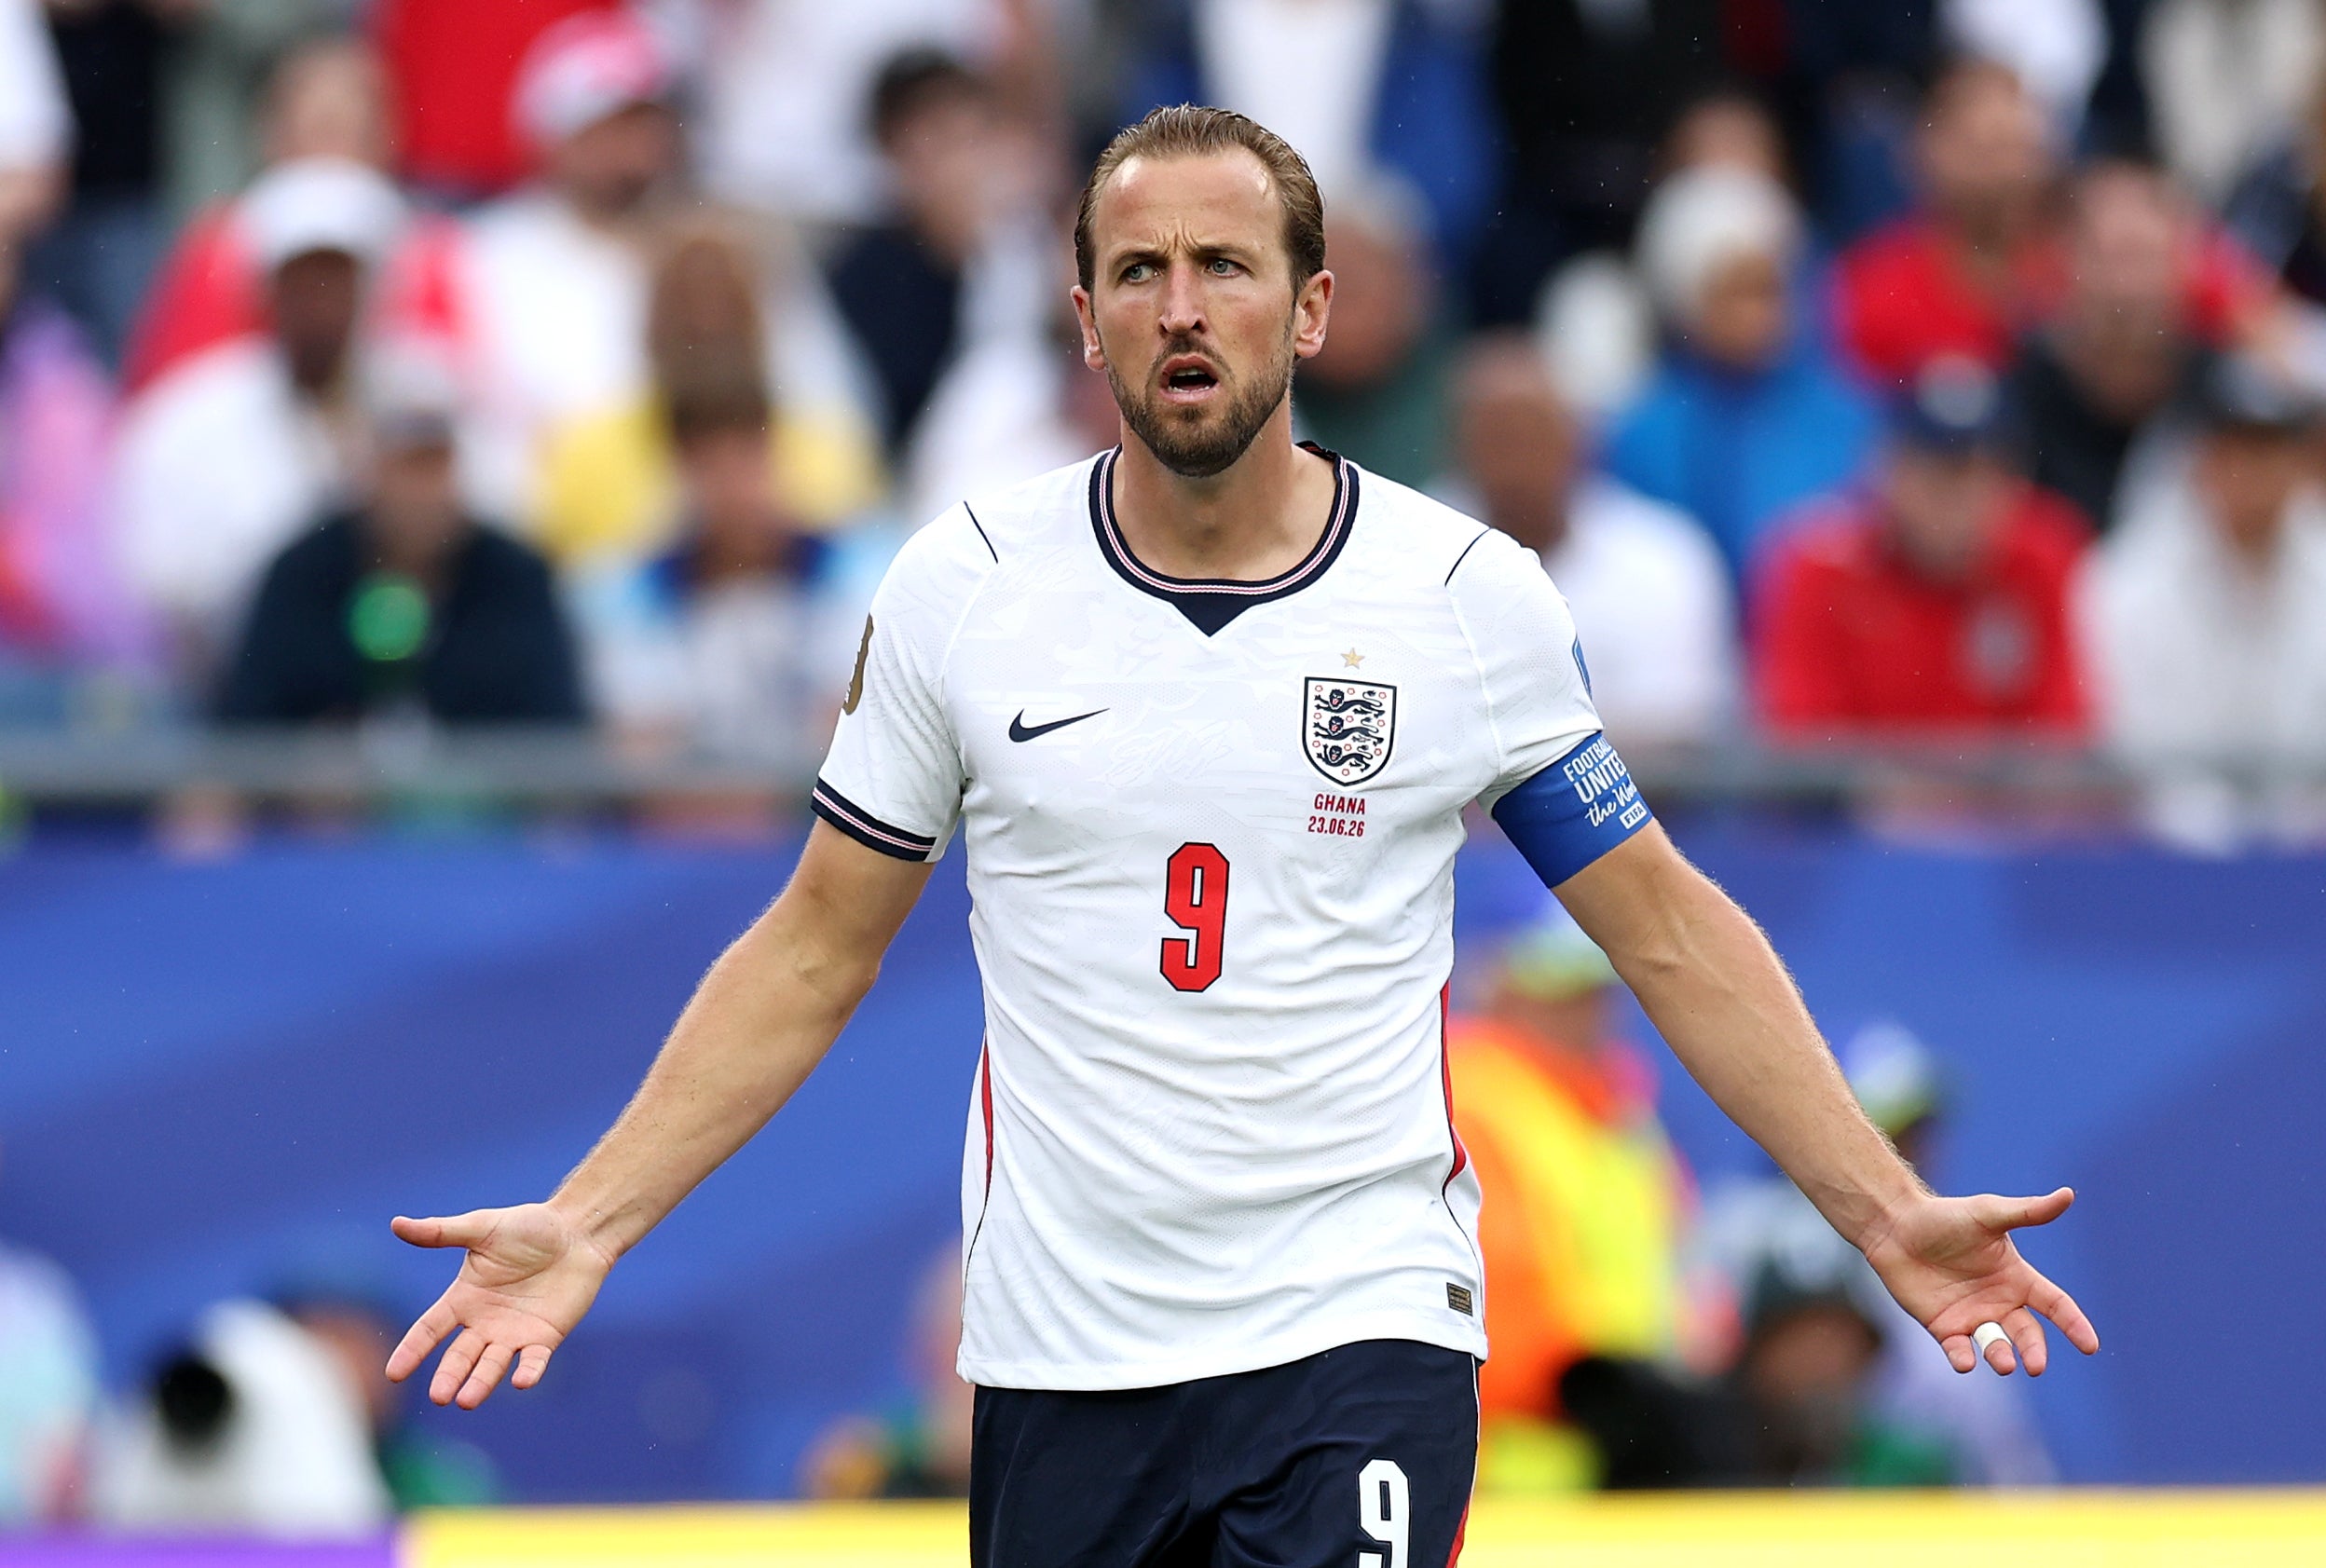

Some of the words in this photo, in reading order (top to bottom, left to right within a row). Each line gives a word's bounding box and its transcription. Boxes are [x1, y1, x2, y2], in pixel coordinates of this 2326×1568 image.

[1314, 793, 1366, 815] GHANA
[1584, 801, 1617, 827] the
[1624, 806, 1644, 825] FIFA
[1307, 816, 1365, 838] 23.06.26
[1159, 841, 1229, 992] 9
[1358, 1458, 1411, 1568] 9
